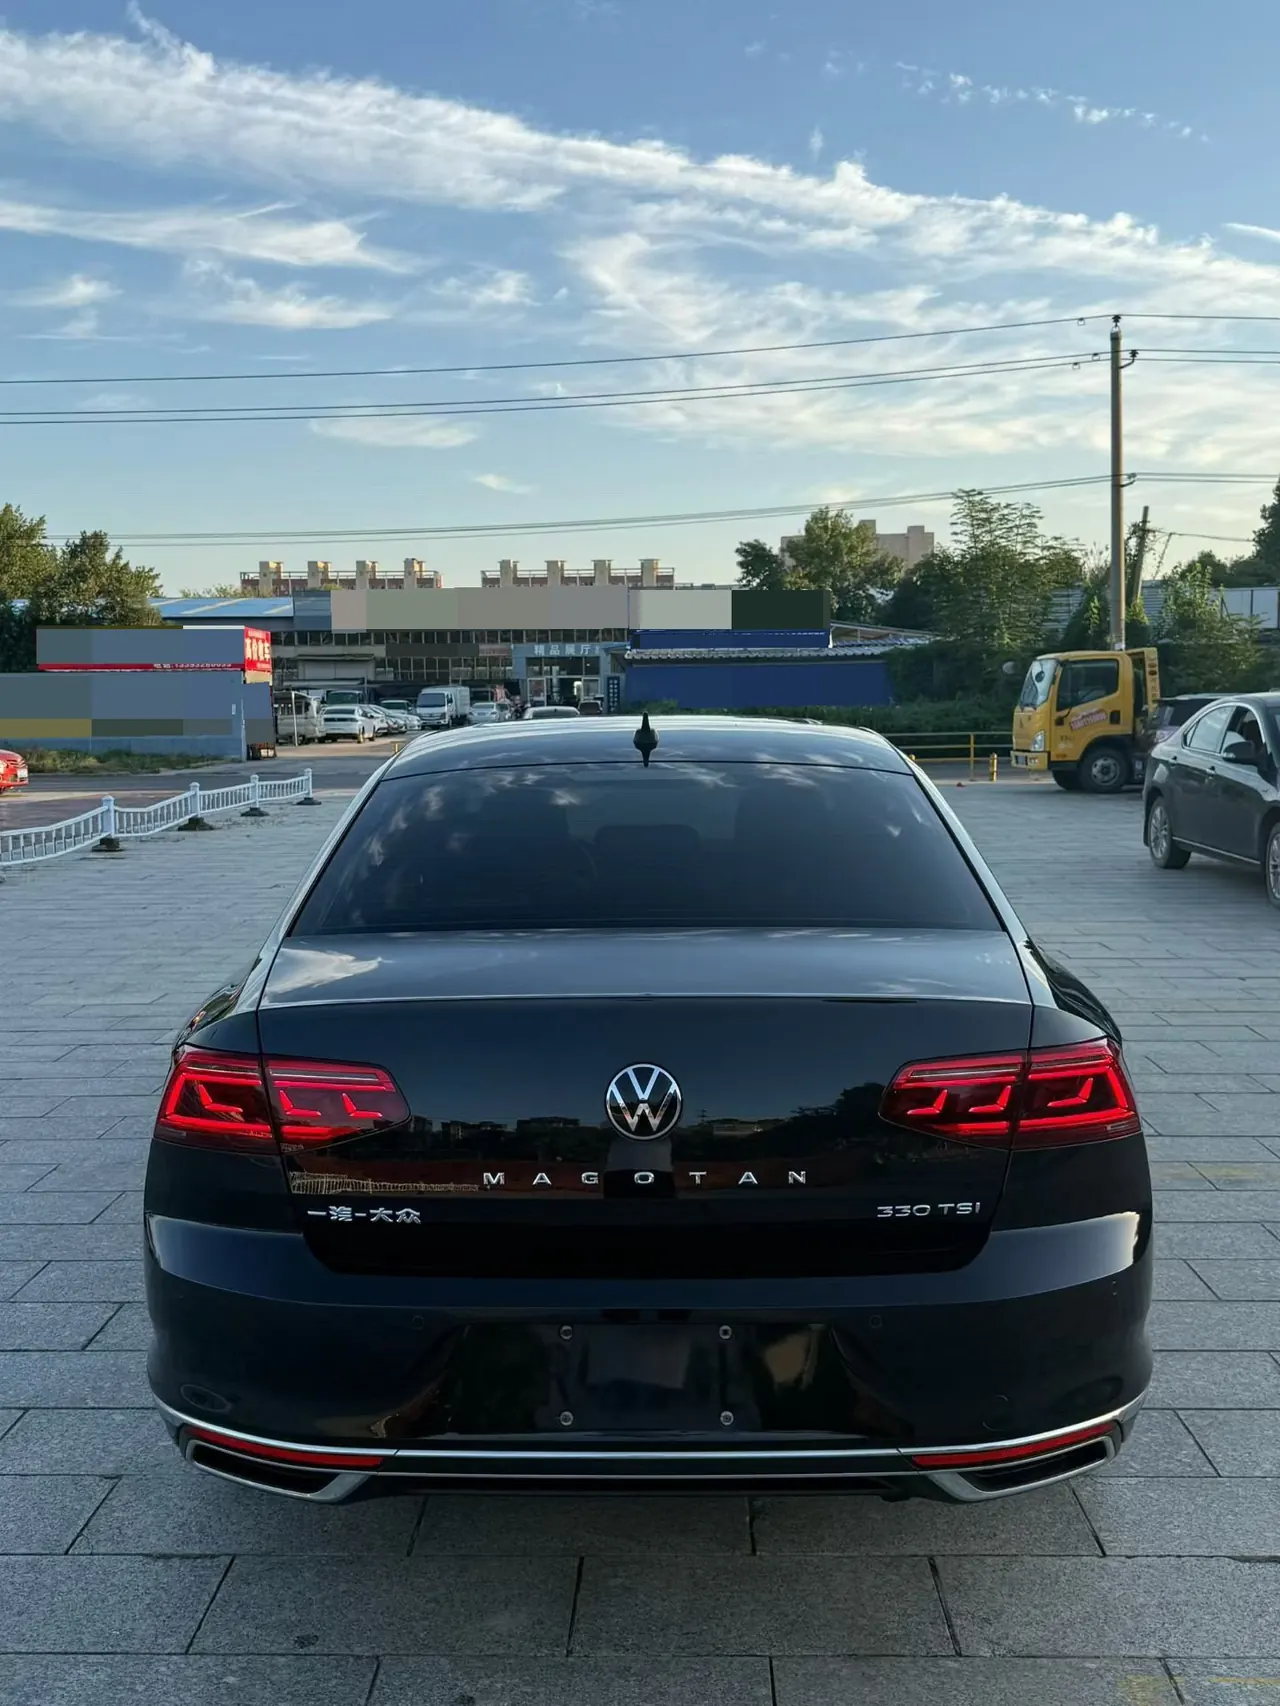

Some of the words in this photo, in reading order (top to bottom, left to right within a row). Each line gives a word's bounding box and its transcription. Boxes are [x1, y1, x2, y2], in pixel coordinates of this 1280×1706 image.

[534, 643, 592, 656] 精品展厅
[482, 1171, 806, 1185] MAGOTAN
[307, 1205, 421, 1224] 一汽-大众
[877, 1204, 931, 1218] 330
[938, 1202, 981, 1215] TSI
